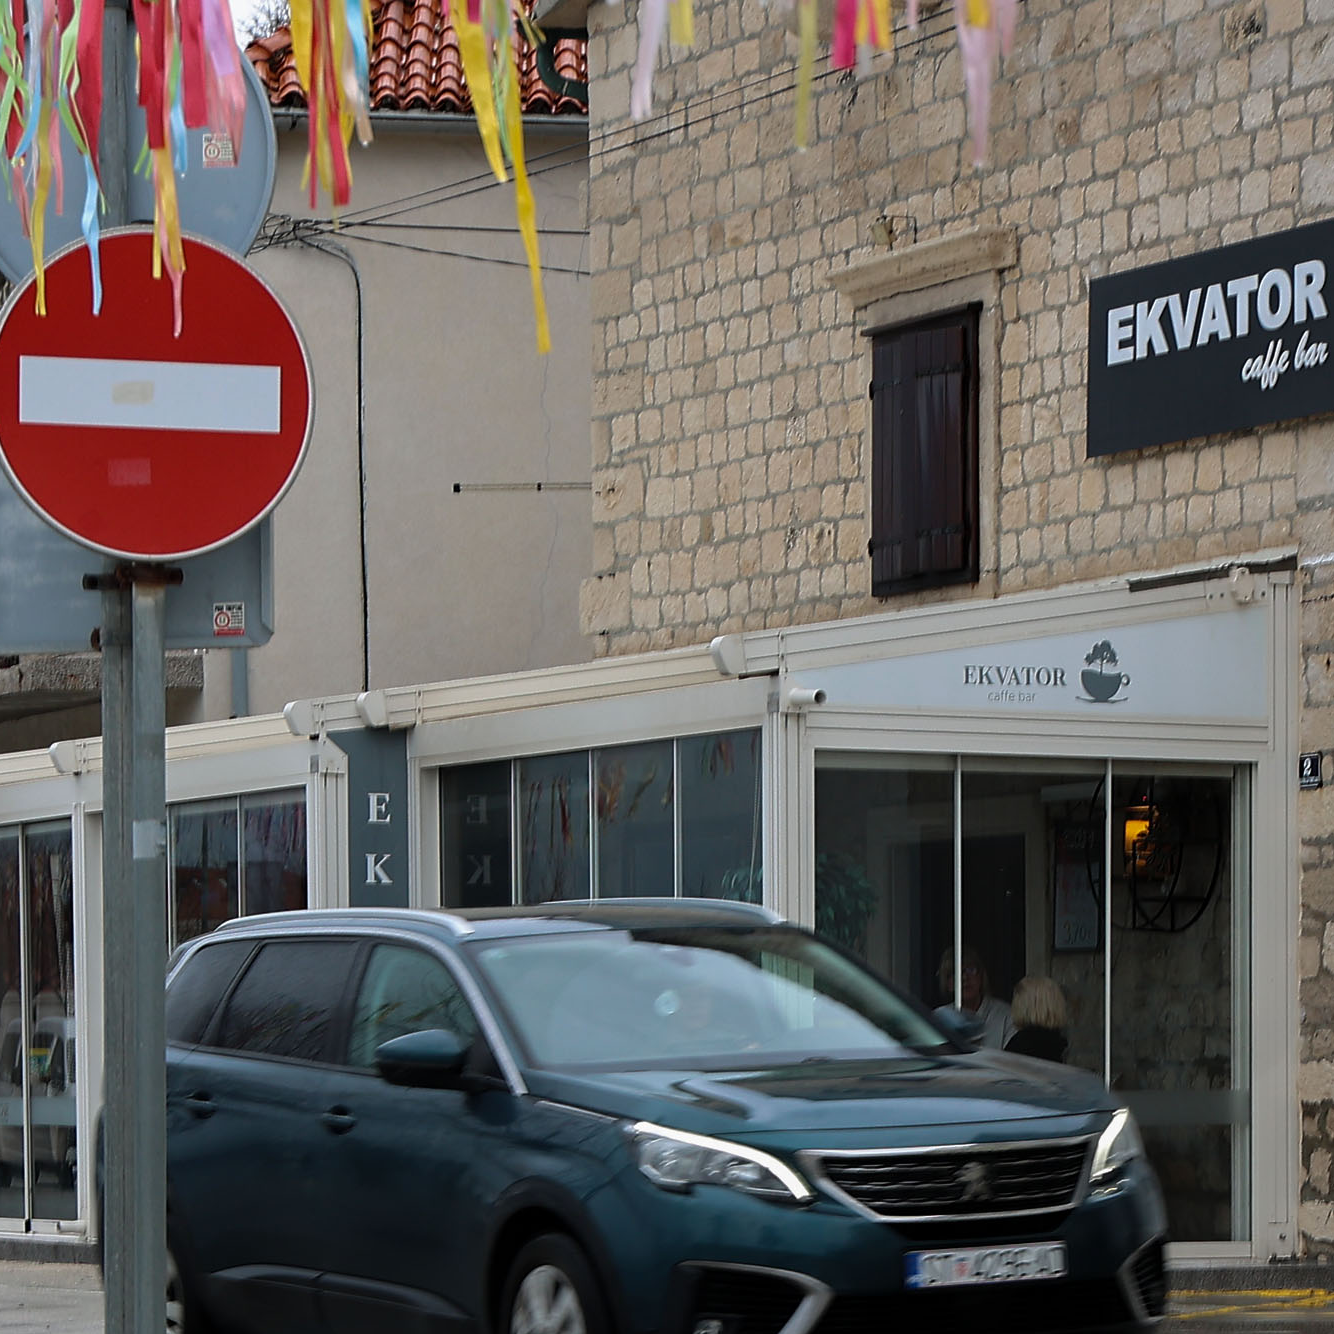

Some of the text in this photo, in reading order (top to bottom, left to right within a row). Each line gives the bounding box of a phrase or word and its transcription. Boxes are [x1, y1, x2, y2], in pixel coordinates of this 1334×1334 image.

[1107, 259, 1329, 367] EKVATOR
[1241, 330, 1329, 391] caffe bar
[963, 664, 1067, 687] EKVATOR
[987, 689, 1036, 703] caffe bar
[1303, 757, 1312, 777] 2
